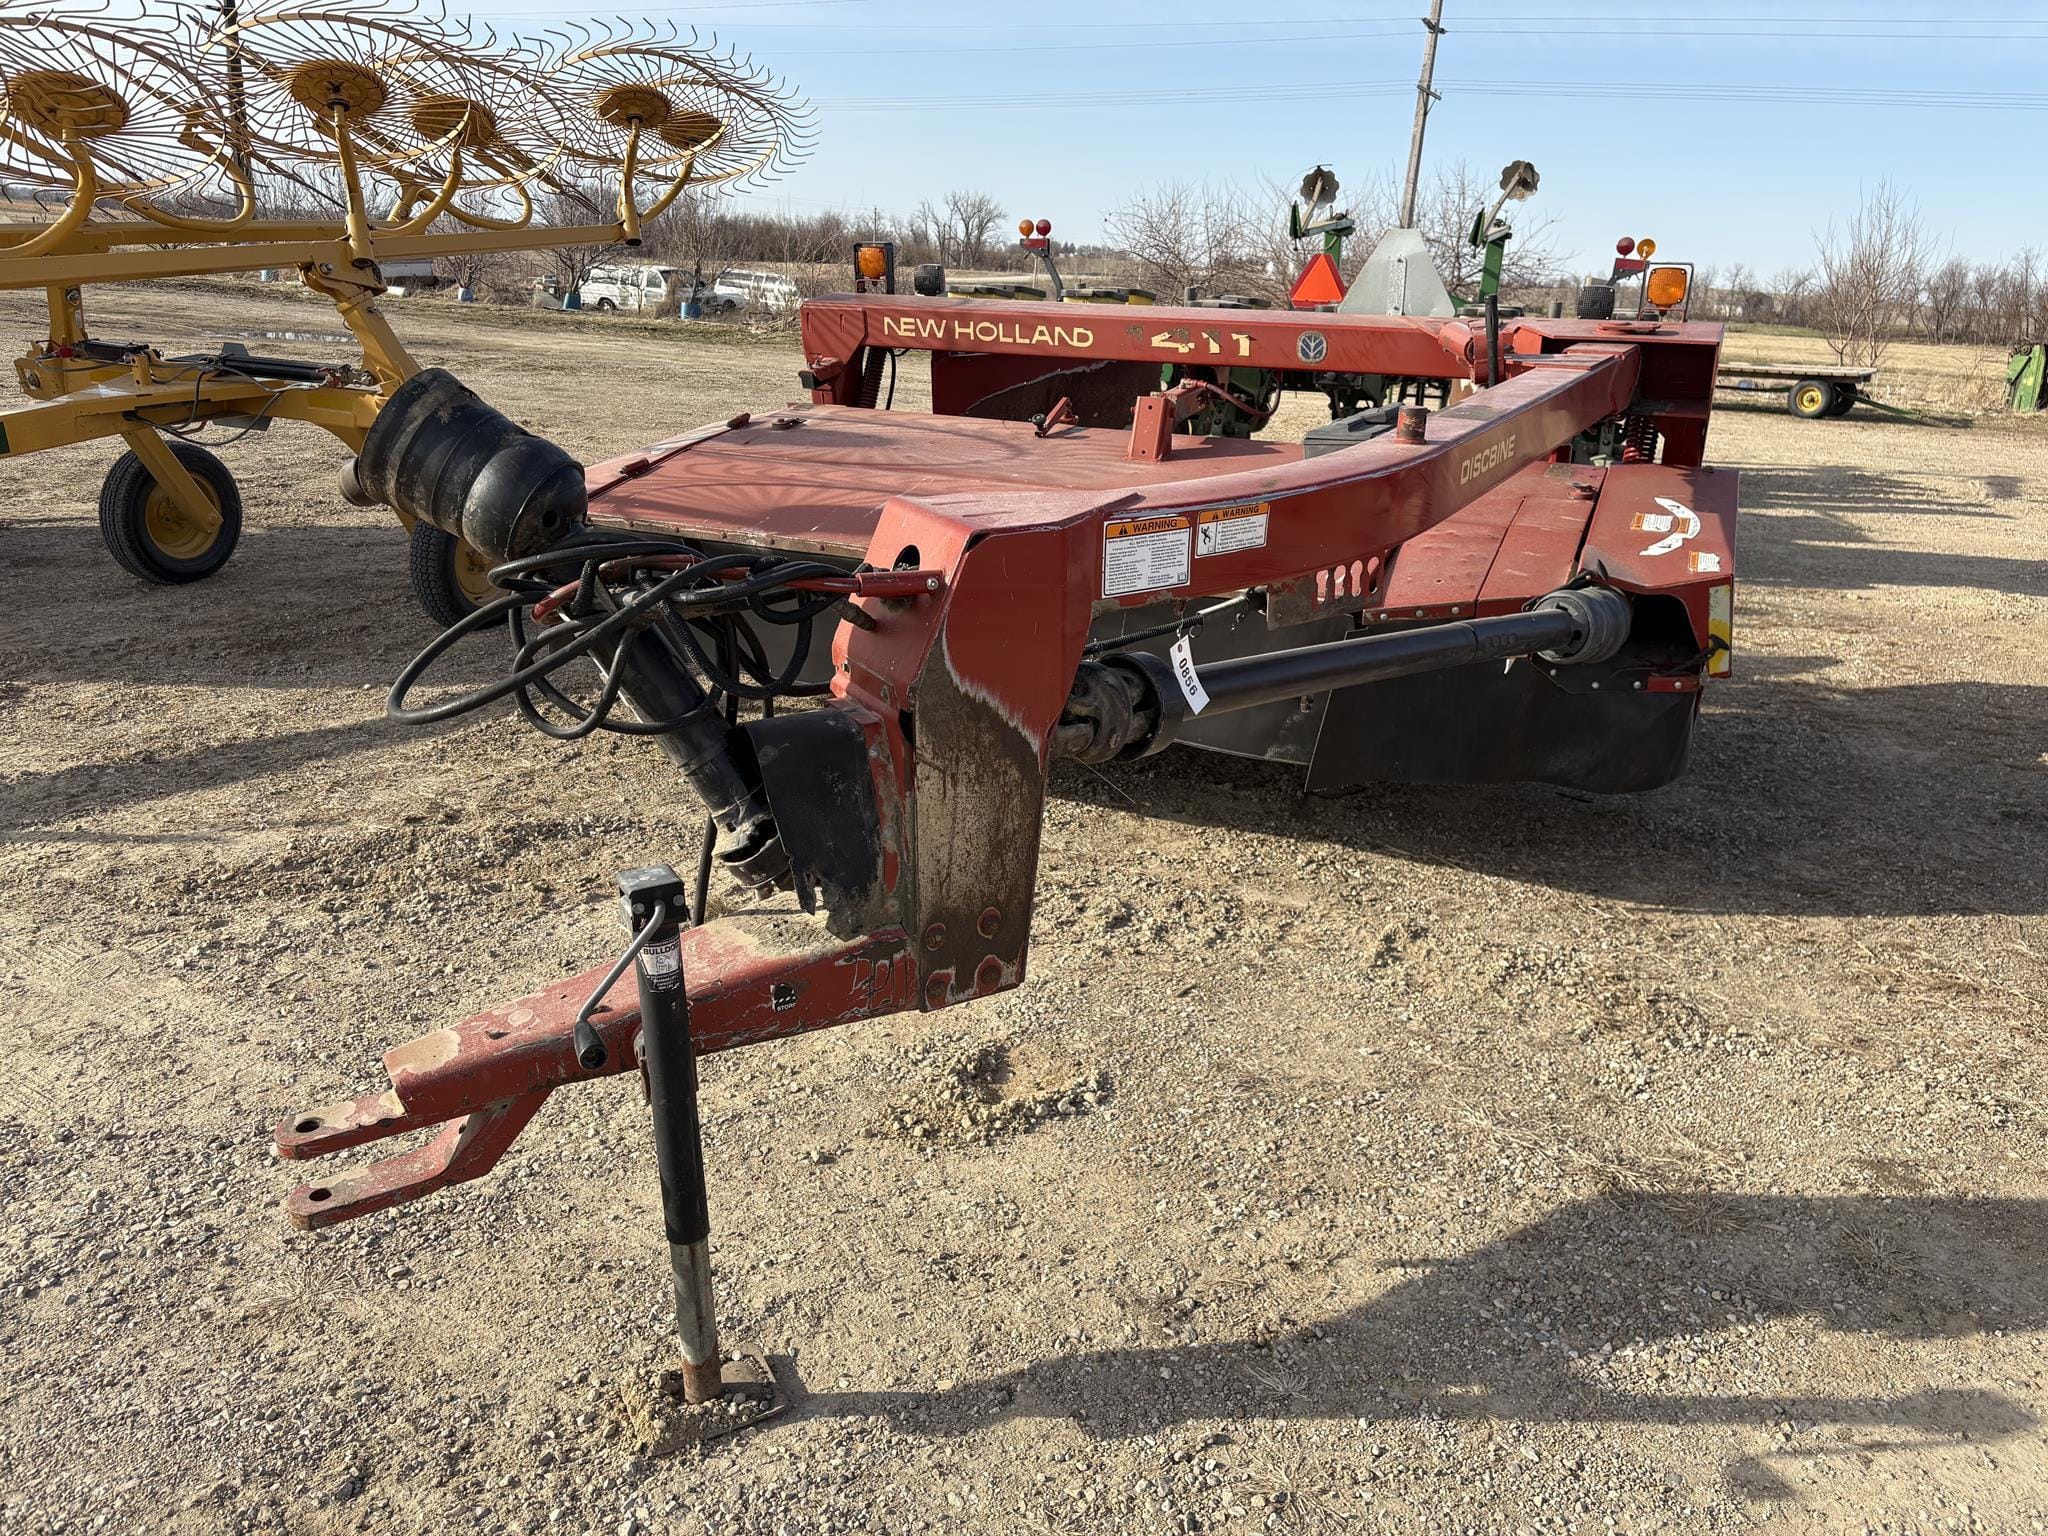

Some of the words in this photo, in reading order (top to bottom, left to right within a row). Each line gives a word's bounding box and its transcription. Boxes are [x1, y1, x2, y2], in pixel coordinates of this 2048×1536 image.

[884, 317, 947, 339] NEW
[955, 320, 1094, 348] HOLLAND
[1460, 434, 1517, 486] DISCBINE
[1133, 519, 1178, 533] WARNING
[1222, 505, 1259, 518] WARNING
[1178, 657, 1199, 697] 0856
